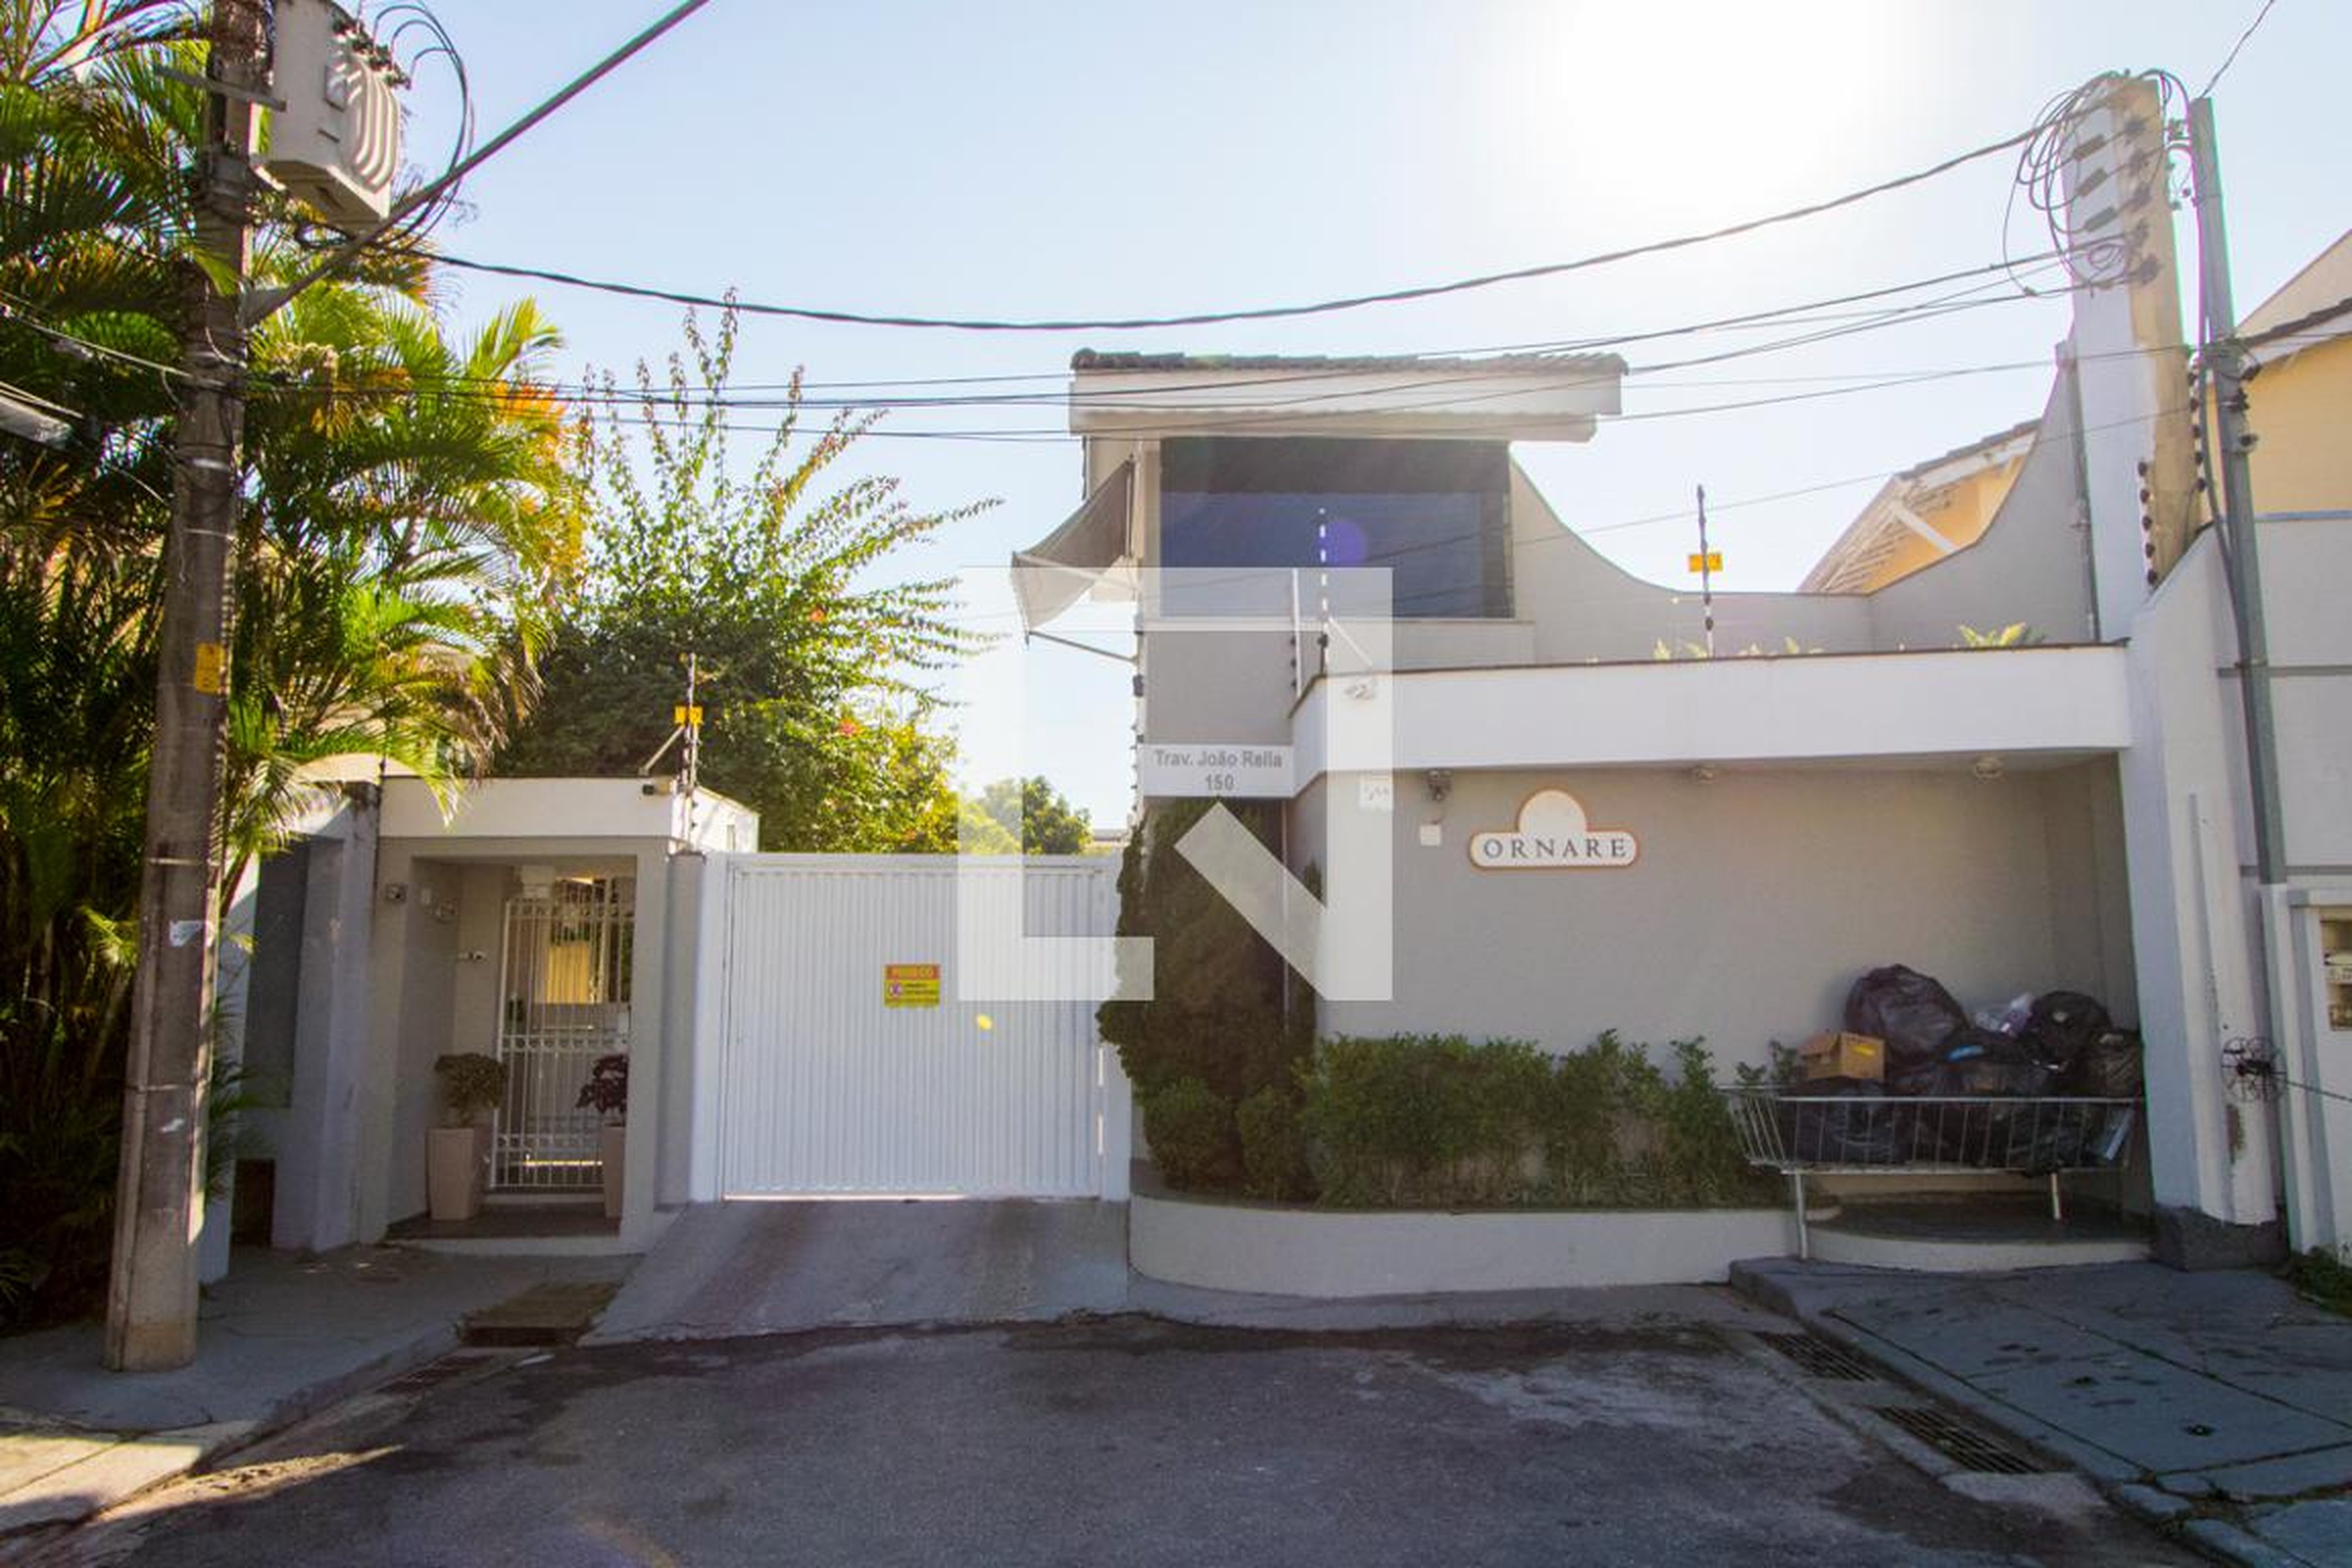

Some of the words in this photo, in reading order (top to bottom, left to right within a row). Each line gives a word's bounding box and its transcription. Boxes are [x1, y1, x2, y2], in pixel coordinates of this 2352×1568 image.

[1155, 750, 1193, 766] Trav.
[1205, 774, 1235, 791] 150
[1483, 838, 1627, 858] ORNARE
